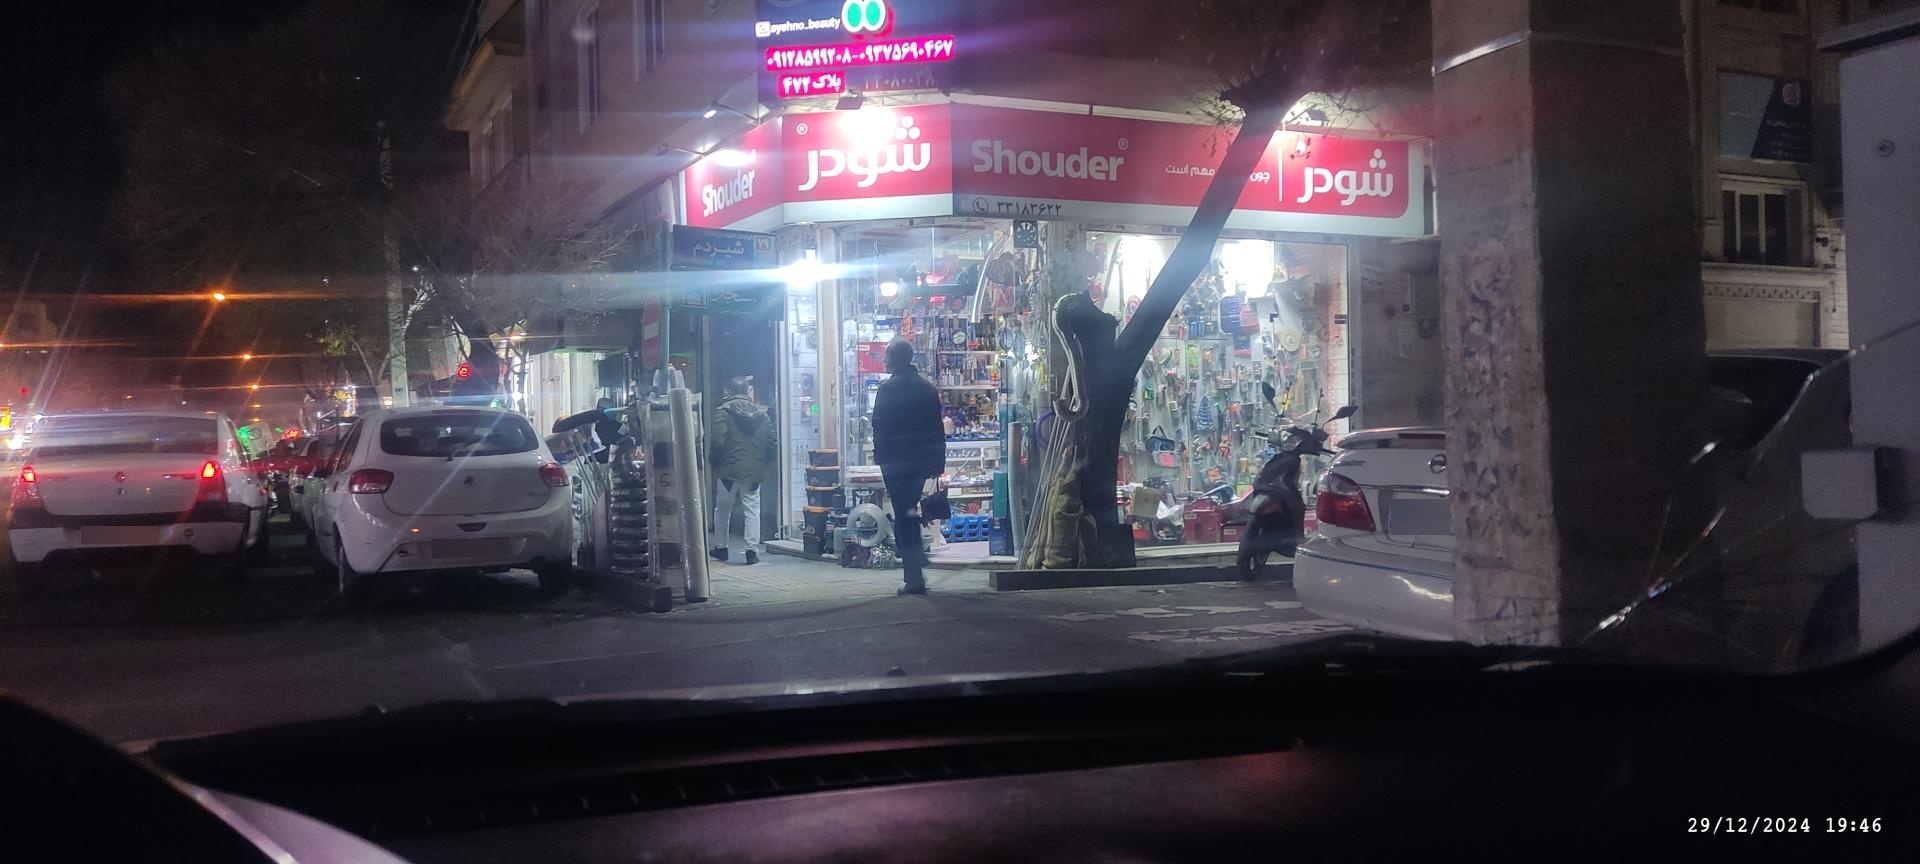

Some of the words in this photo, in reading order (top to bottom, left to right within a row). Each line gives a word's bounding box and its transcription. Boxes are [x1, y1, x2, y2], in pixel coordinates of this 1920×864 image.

[812, 73, 842, 92] پلاک
[798, 115, 931, 191] شودر
[971, 138, 1124, 183] Shouder
[1165, 164, 1189, 174] است
[702, 168, 756, 217] Shouder
[1297, 148, 1394, 207] شودر
[996, 201, 1063, 217] ۳۳۱۸۳۶۲۲
[693, 239, 745, 258] شیردم
